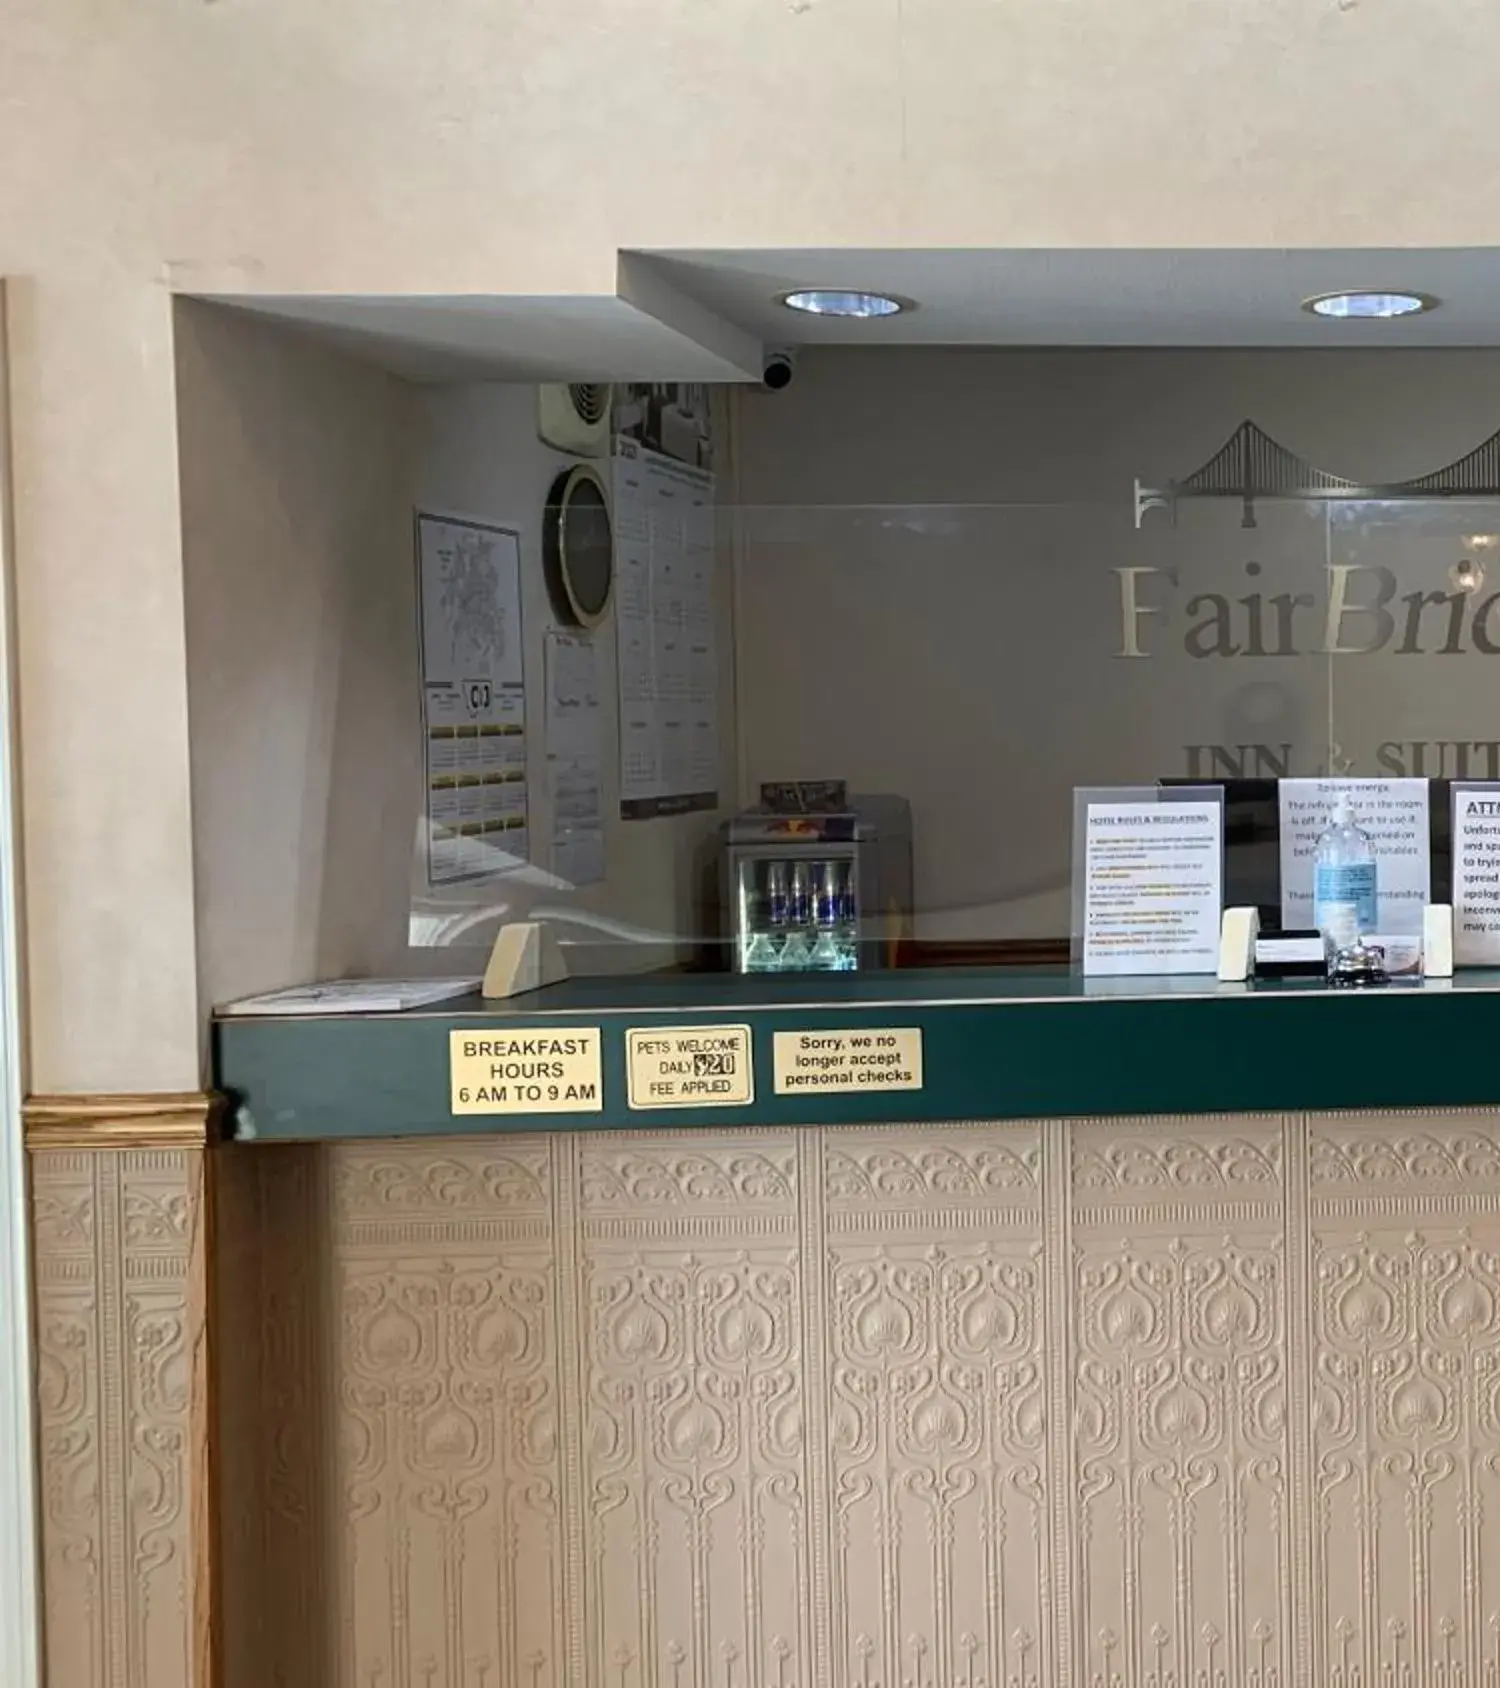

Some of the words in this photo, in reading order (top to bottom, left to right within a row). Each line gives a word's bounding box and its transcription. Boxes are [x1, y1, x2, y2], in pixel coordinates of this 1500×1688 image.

[1183, 744, 1292, 779] INN
[1463, 842, 1483, 850] and
[1463, 857, 1475, 866] to
[1463, 874, 1499, 883] spread
[1463, 923, 1486, 932] may
[463, 1039, 589, 1057] BREAKFAST
[637, 1041, 671, 1054] PETS
[677, 1038, 741, 1053] WELCOME
[800, 1036, 845, 1051] Sorry,
[850, 1037, 872, 1048] we
[876, 1036, 897, 1047] no
[795, 1054, 845, 1069] longer
[849, 1052, 902, 1067] accept
[490, 1061, 564, 1079] HOURS
[650, 1081, 675, 1096] FEE
[681, 1079, 732, 1095] APPLIED
[785, 1071, 853, 1089] personal
[857, 1069, 913, 1083] checks
[459, 1087, 470, 1103] 6
[475, 1086, 507, 1102] AM
[514, 1085, 541, 1101] TO
[547, 1085, 559, 1101] 9
[564, 1083, 596, 1100] AM
